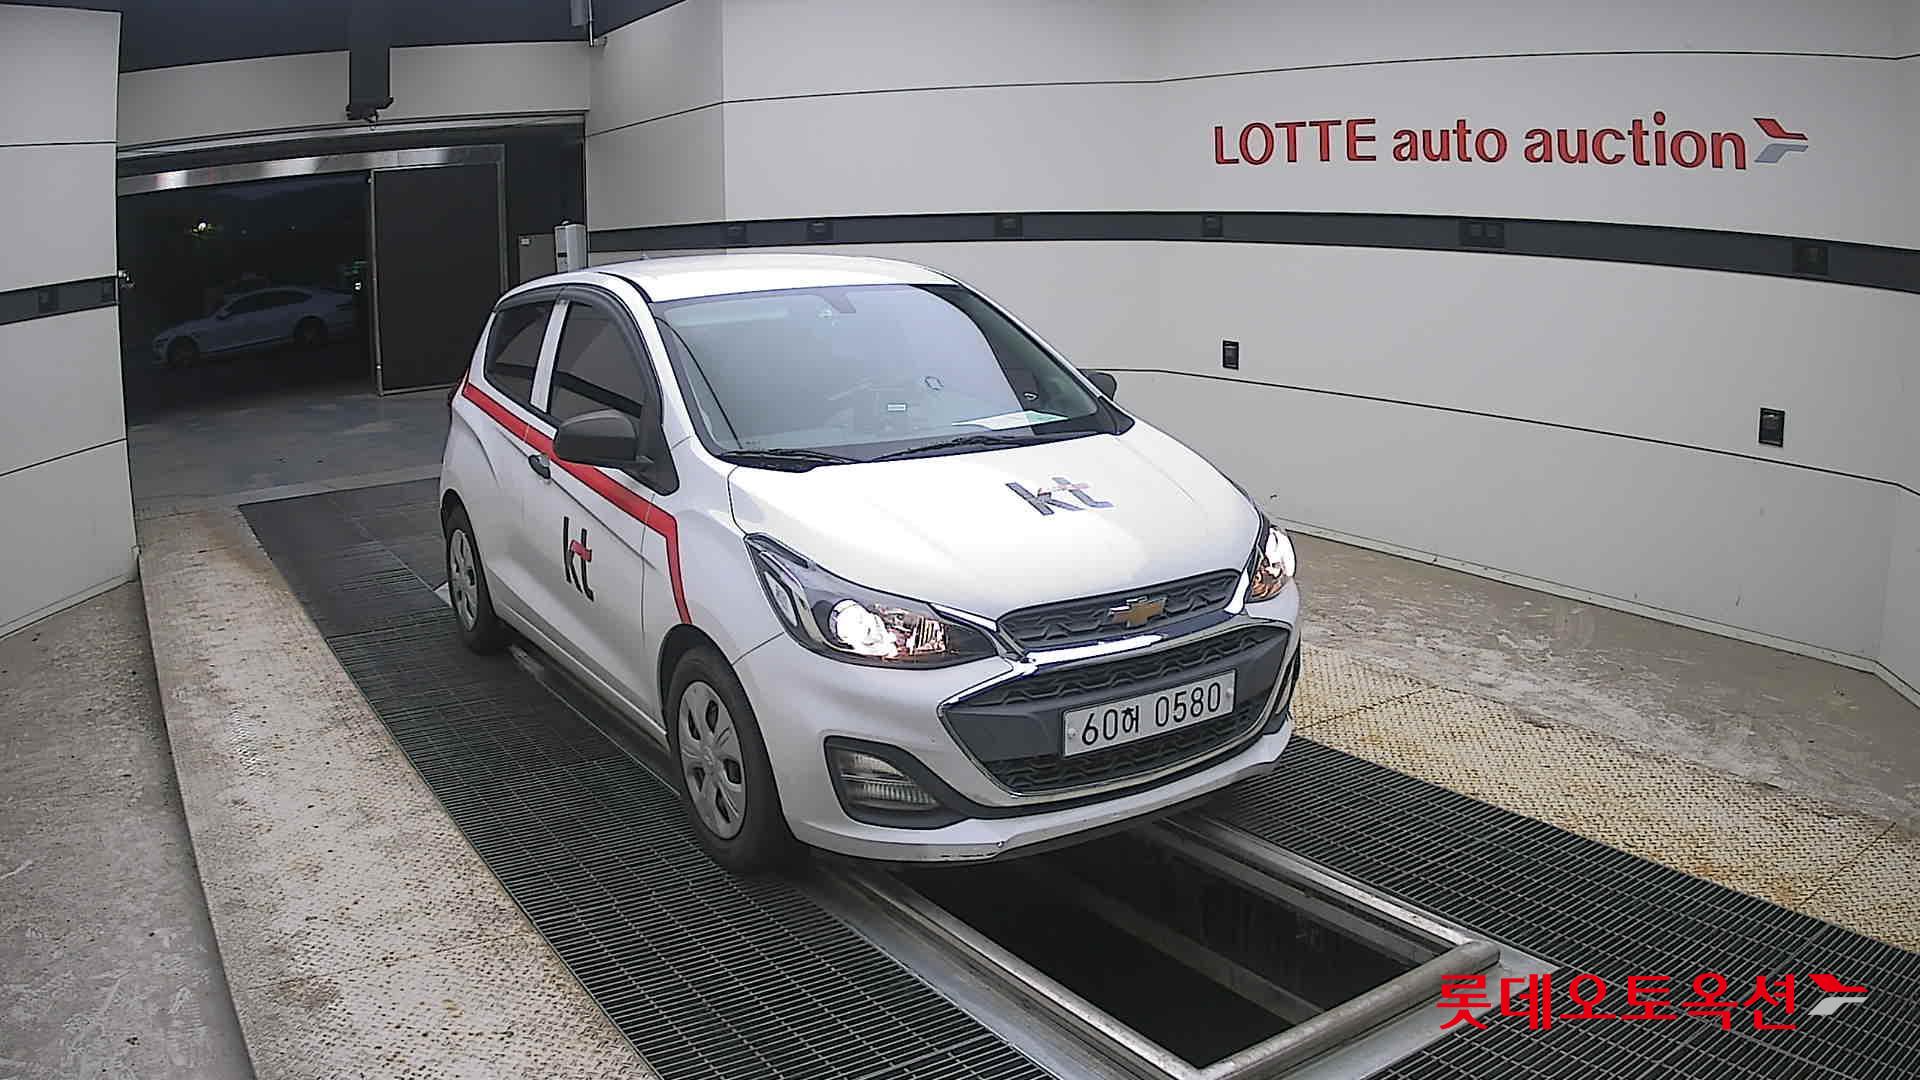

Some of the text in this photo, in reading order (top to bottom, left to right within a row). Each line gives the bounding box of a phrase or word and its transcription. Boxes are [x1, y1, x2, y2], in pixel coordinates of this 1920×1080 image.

[1214, 111, 1748, 170] LOTTE auto auction
[1005, 476, 1114, 516] kt
[563, 516, 594, 602] kt
[1082, 682, 1221, 745] 60허 0580
